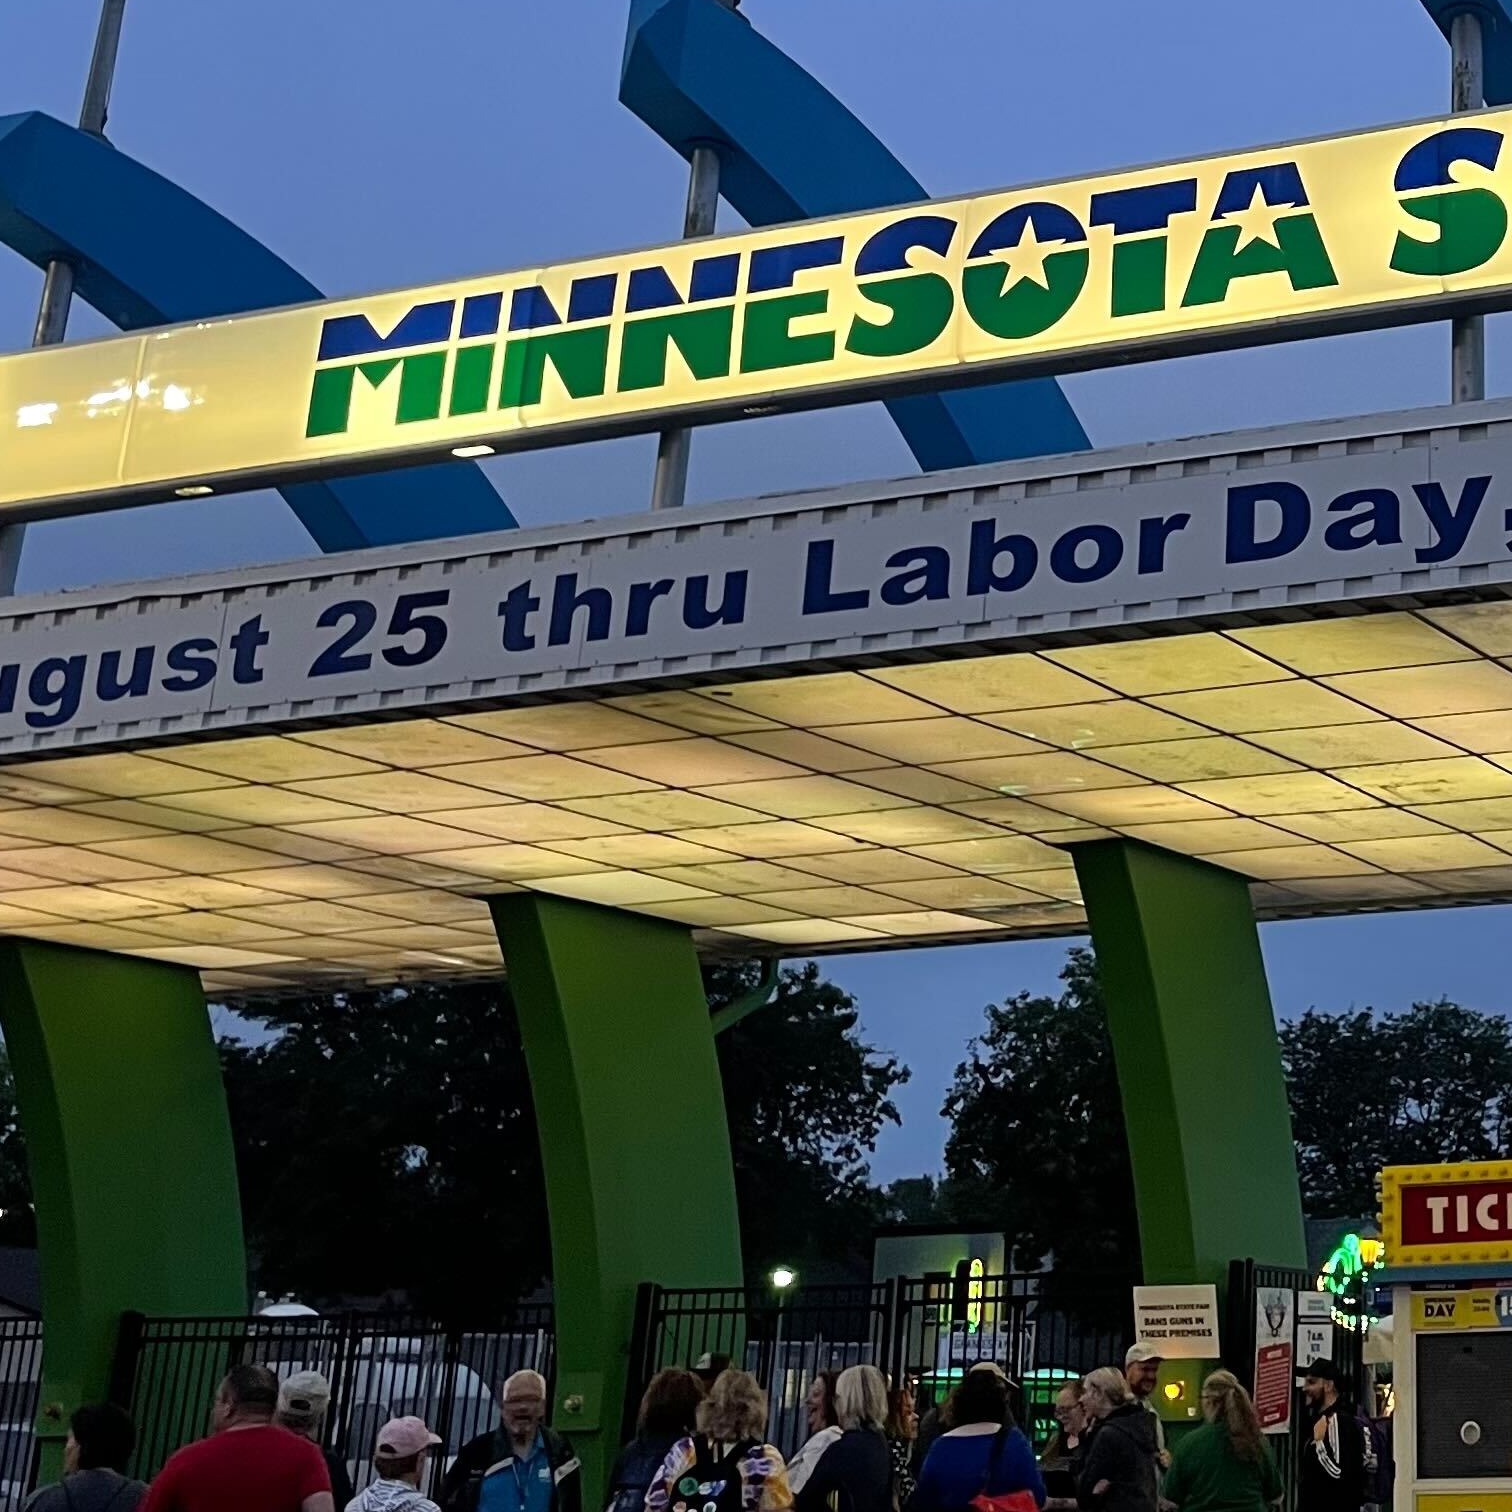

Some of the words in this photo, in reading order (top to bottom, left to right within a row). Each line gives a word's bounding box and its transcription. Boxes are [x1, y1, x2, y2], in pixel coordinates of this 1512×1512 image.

[306, 161, 1338, 437] MINNESOTA
[308, 590, 450, 678] 25
[499, 570, 748, 652] thru
[803, 513, 1191, 615] Labor
[1425, 1304, 1455, 1318] DAY
[1144, 1318, 1167, 1326] BANS
[1170, 1317, 1193, 1325] GUNS
[1140, 1329, 1167, 1338] THESE
[1169, 1329, 1212, 1337] PREMISES
